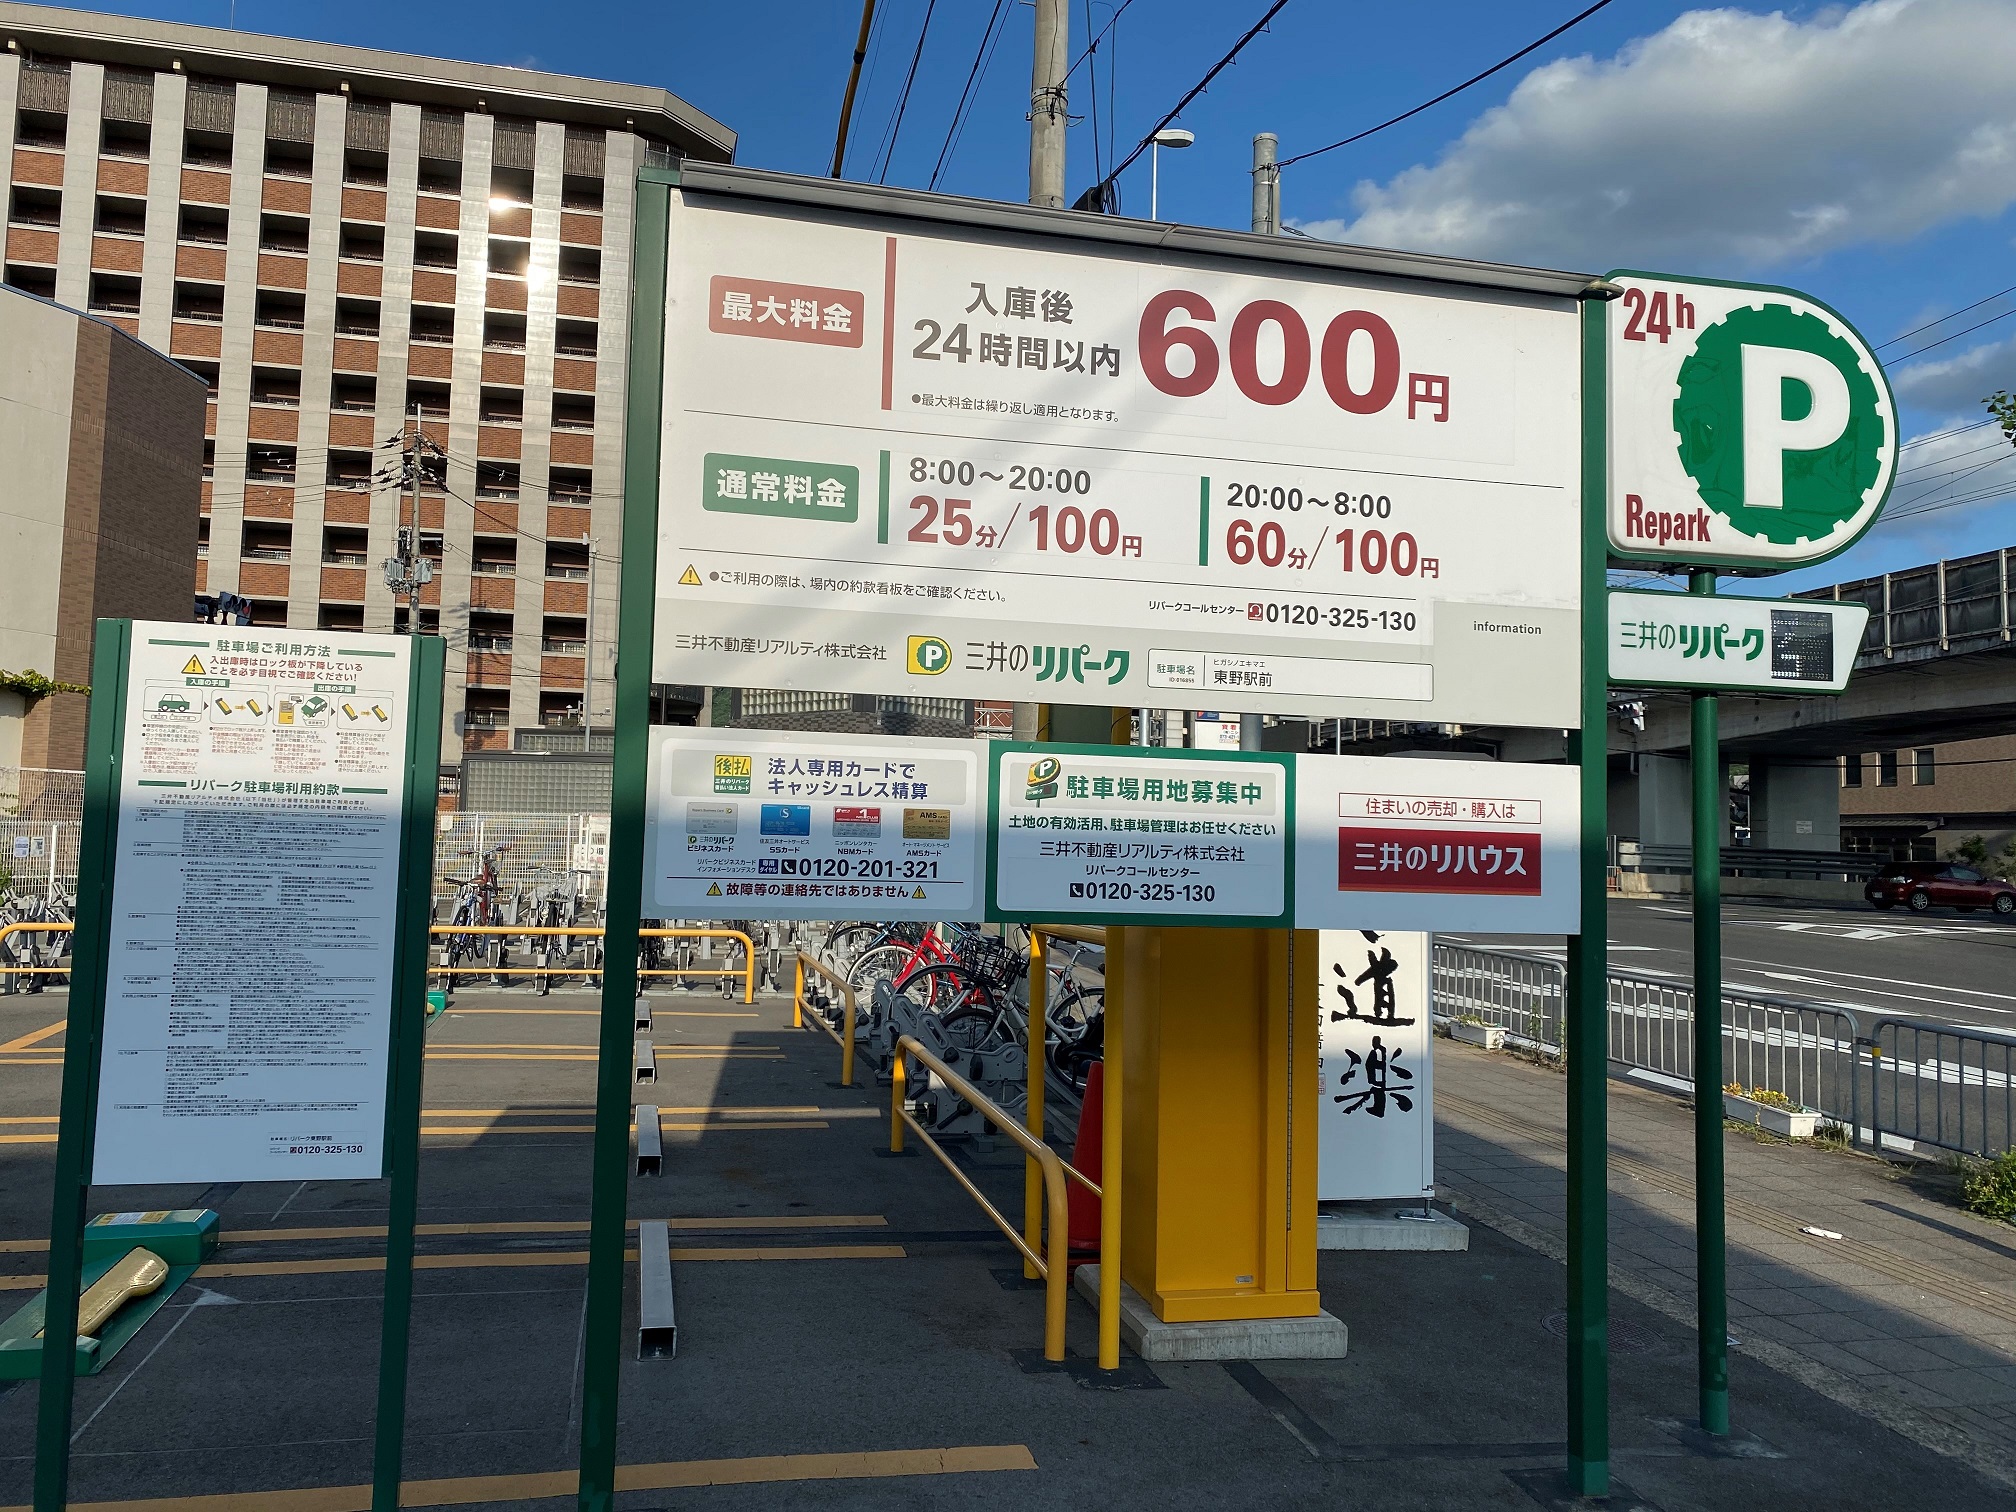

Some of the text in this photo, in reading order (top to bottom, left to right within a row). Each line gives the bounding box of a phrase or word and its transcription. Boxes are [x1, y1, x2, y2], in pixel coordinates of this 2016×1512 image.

[722, 289, 854, 335] 最大料金
[965, 281, 1074, 325] 入庫後
[1623, 287, 1696, 344] 24h
[912, 318, 1121, 378] 24時間以内
[1138, 289, 1450, 423] 600円
[921, 393, 1120, 423] 最大料金は繰り返し適用となります。
[1740, 343, 1851, 509] P
[716, 468, 847, 508] 通常料金
[1626, 493, 1711, 547] Repark
[720, 571, 1006, 602] ご利用の際は、場内の約款看板をご確認ください。
[1148, 600, 1416, 631] リパークコールセンター 0120-325-130
[1473, 620, 1541, 635] information
[217, 639, 331, 657] 駐車場ご利用方法
[675, 634, 887, 661] 三井不動産リアルティ株式会社
[1620, 621, 1764, 661] 三井のリパーク
[210, 655, 363, 672] 入出庫時はロック板が下降している
[965, 641, 1130, 686] 三井のリパーク
[1157, 663, 1195, 675] 駐車場名
[1213, 659, 1265, 668] ヒガシノエキマエ
[317, 684, 352, 693] 出庫の手順
[1213, 670, 1272, 687] 東野駅前
[716, 757, 750, 775] 後払
[768, 757, 916, 778] 法人専用カードで
[190, 779, 340, 796] リパーク駐車場利用約款
[768, 778, 928, 800] キャッシュレス精算
[1066, 775, 1262, 805] 駐車場用地募集中
[1365, 798, 1516, 819] 住まいの売却・購入は
[1008, 816, 1276, 836] 土地の有効活用、駐車場管理はお任せください
[699, 836, 734, 844] 三井のリパーク
[1040, 841, 1245, 862] 三井不動産リアルティ株式会社
[1354, 842, 1527, 876] 三井のリハウス
[799, 859, 938, 879] 0120-201-321
[1085, 864, 1200, 877] リパークコールセンター
[726, 882, 909, 898] 故障等の連絡先ではありません
[1085, 881, 1215, 903] 0120-325-130
[1331, 930, 1415, 1118] 道楽
[297, 1145, 363, 1154] 0120-325-130
